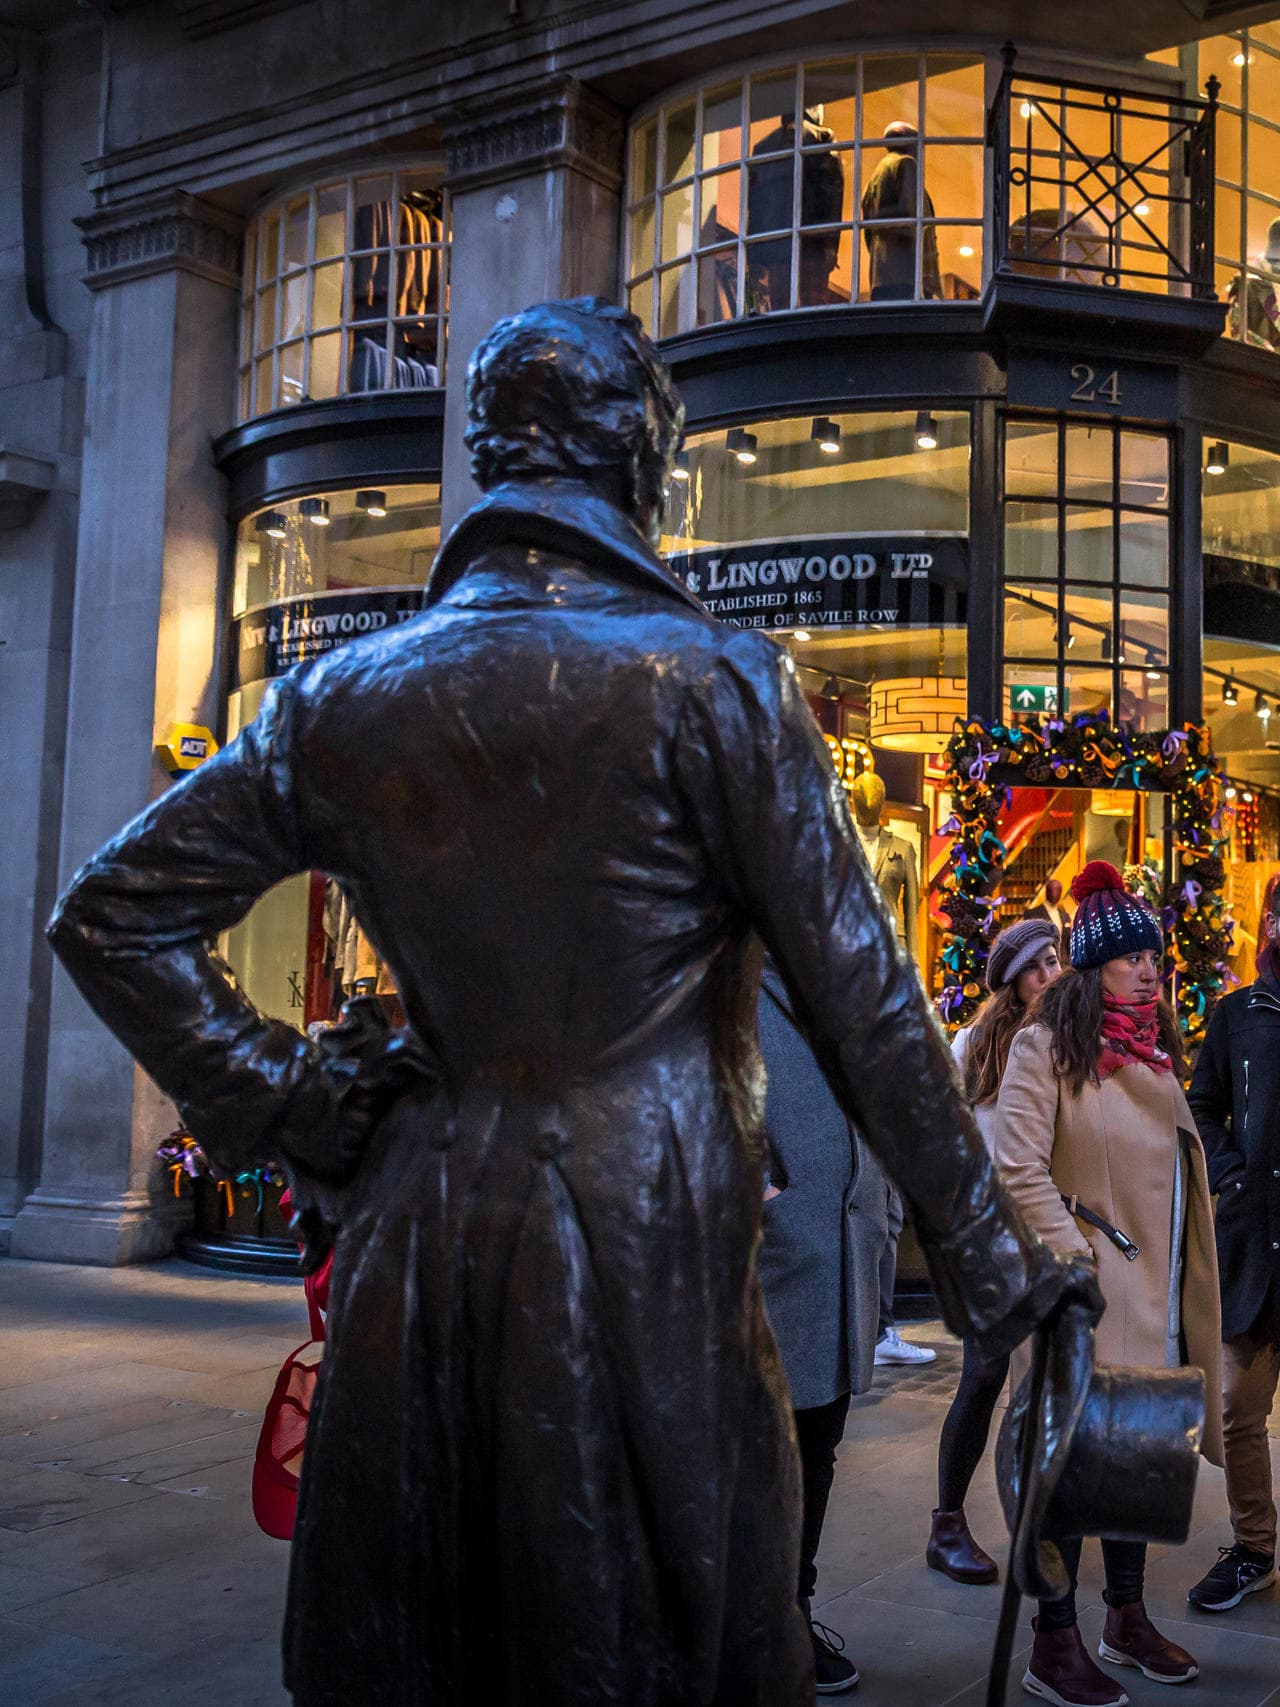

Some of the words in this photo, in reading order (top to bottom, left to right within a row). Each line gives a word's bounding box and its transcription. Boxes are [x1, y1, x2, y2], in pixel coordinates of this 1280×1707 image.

[1071, 363, 1123, 405] 24
[686, 571, 701, 593] &
[702, 592, 788, 612] STABLISHED
[793, 590, 823, 605] 1865
[774, 613, 793, 626] OF
[798, 610, 853, 625] SAVILE
[857, 609, 900, 622] ROW
